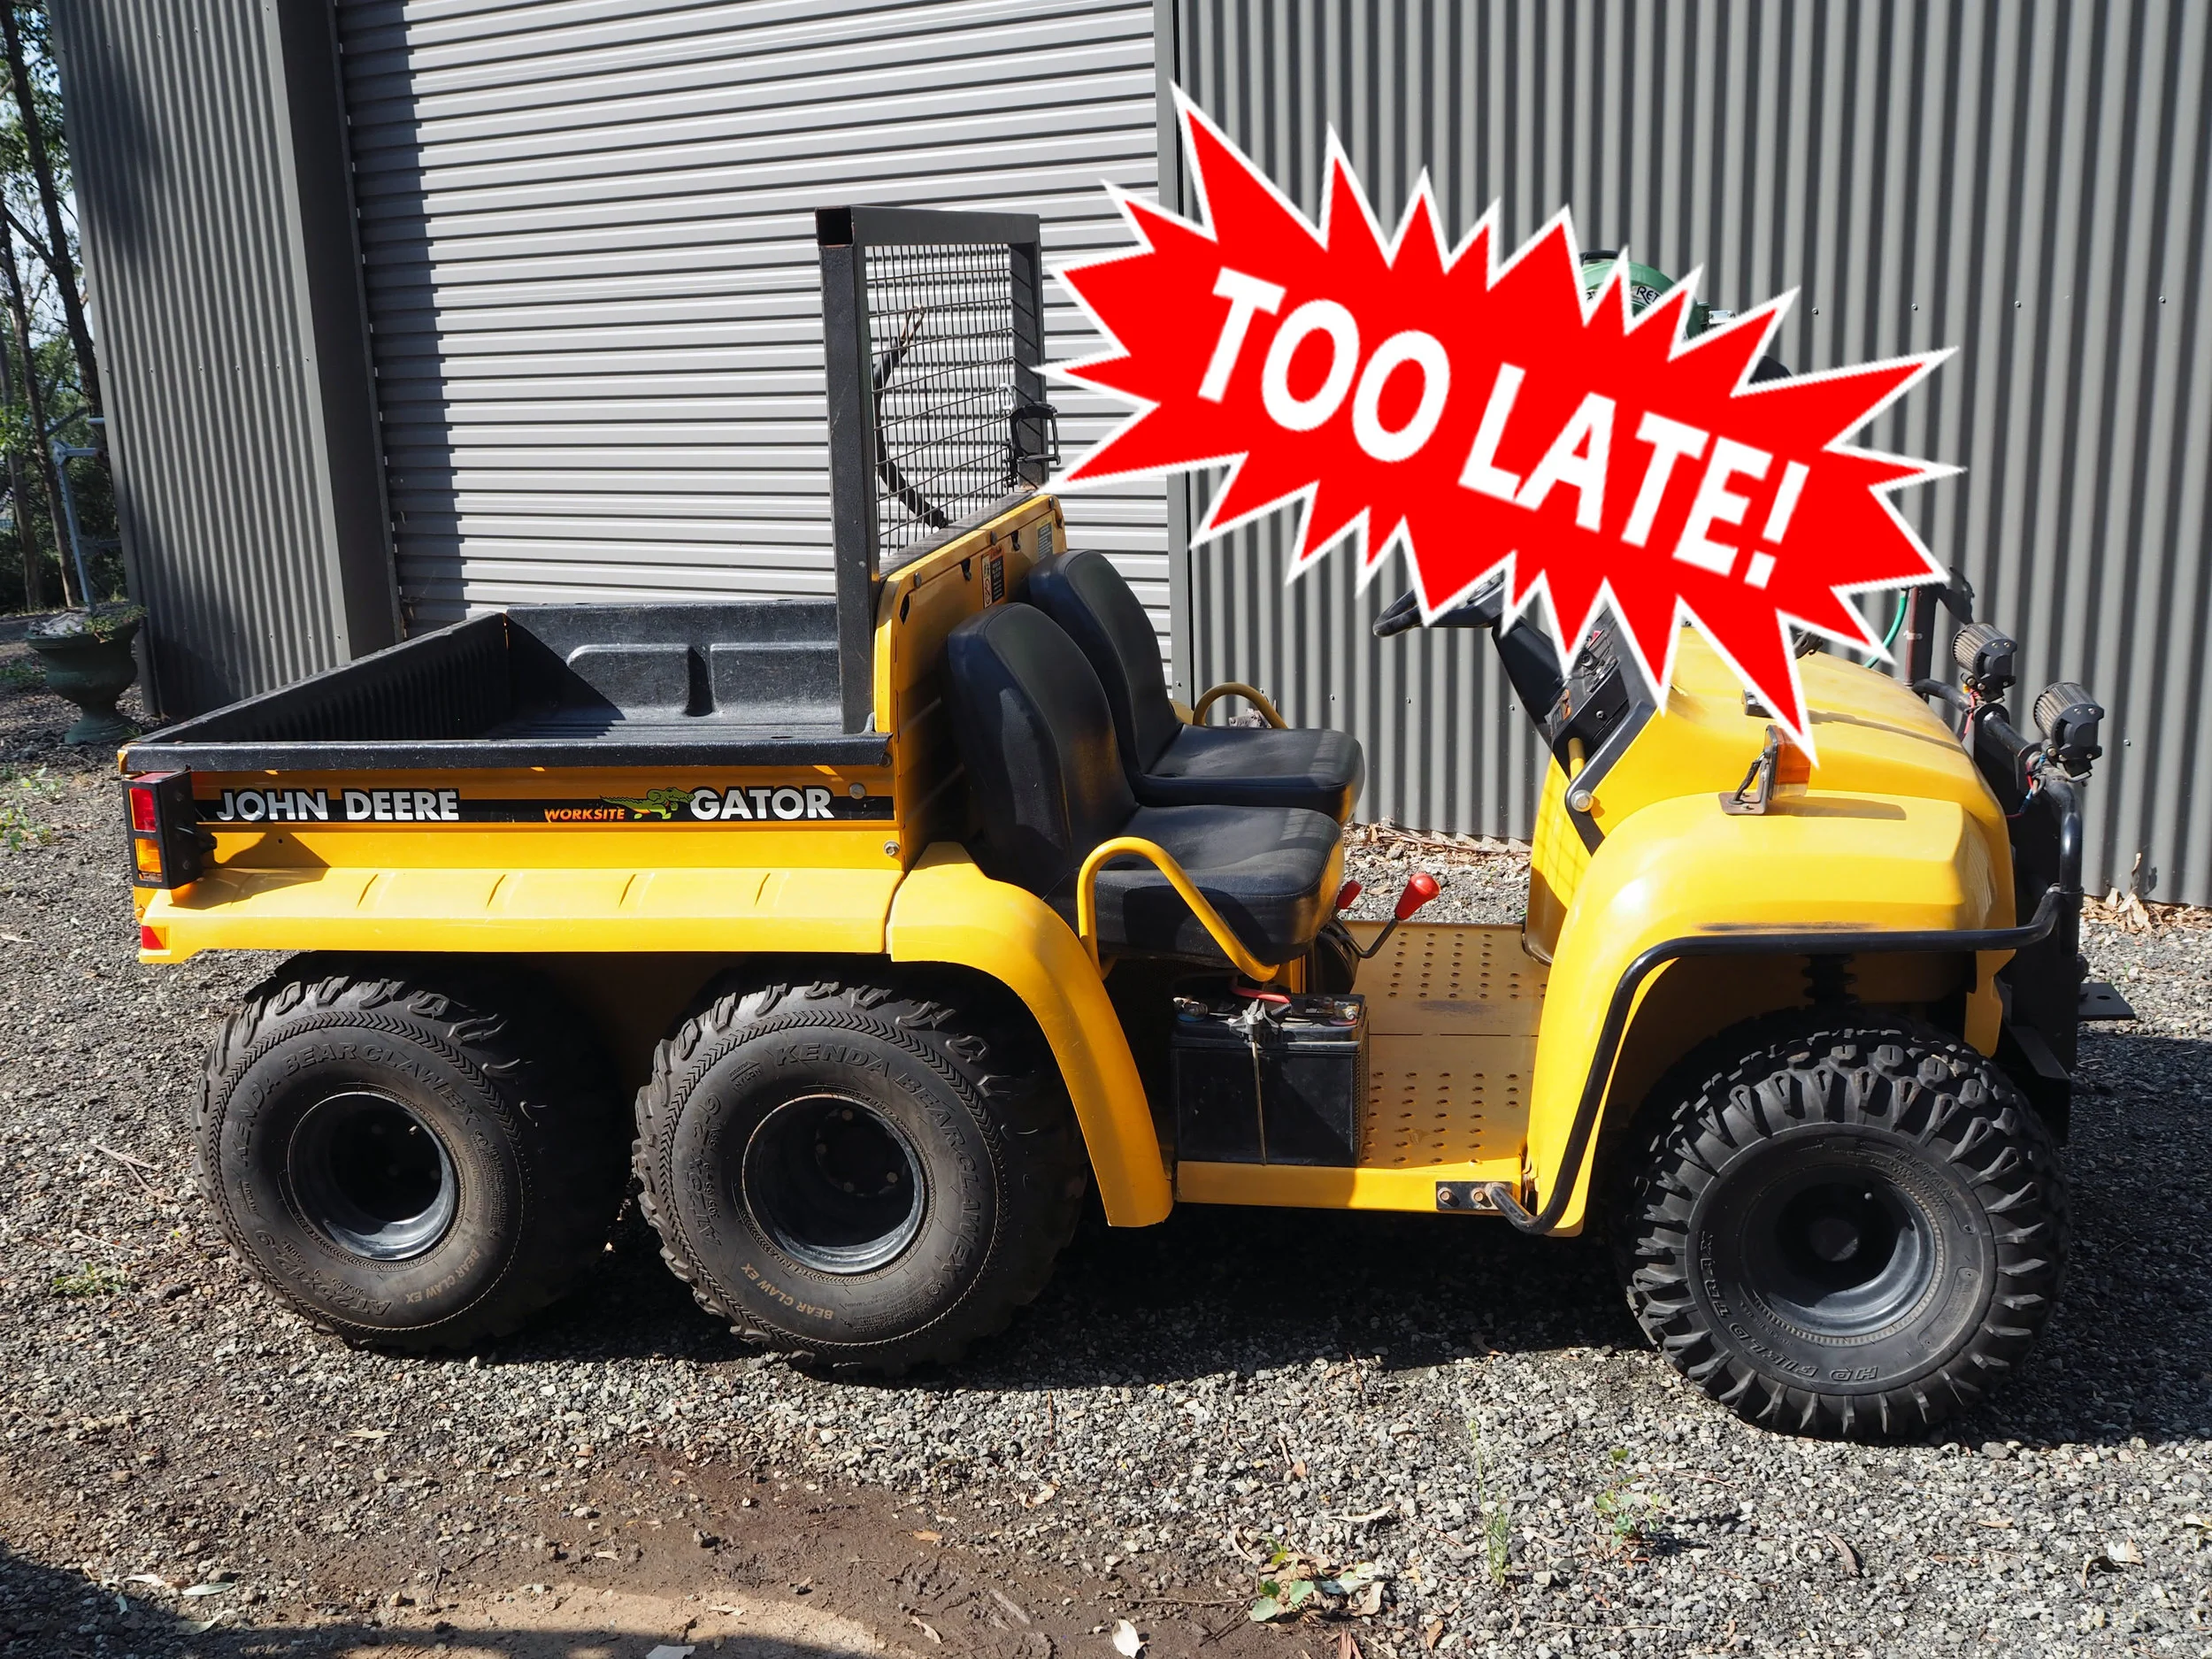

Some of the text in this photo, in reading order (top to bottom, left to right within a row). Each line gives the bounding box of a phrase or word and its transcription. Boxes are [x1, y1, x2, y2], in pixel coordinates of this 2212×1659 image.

[216, 791, 459, 821] JOHN DEERE
[543, 787, 834, 823] WORKSITE GATOR
[282, 1043, 357, 1077] BEAR
[363, 1044, 449, 1091] CLAW
[772, 1043, 890, 1078] KENDA
[893, 1072, 966, 1148] BEAR
[956, 1153, 981, 1246] CLAW
[455, 1245, 480, 1279] BEAR
[405, 1291, 423, 1304] EX
[426, 1275, 457, 1300] CLAW
[741, 1263, 834, 1320] BEAR CLAW EX
[1729, 1323, 1819, 1378] FIELD
[1830, 1365, 1879, 1382] HD
